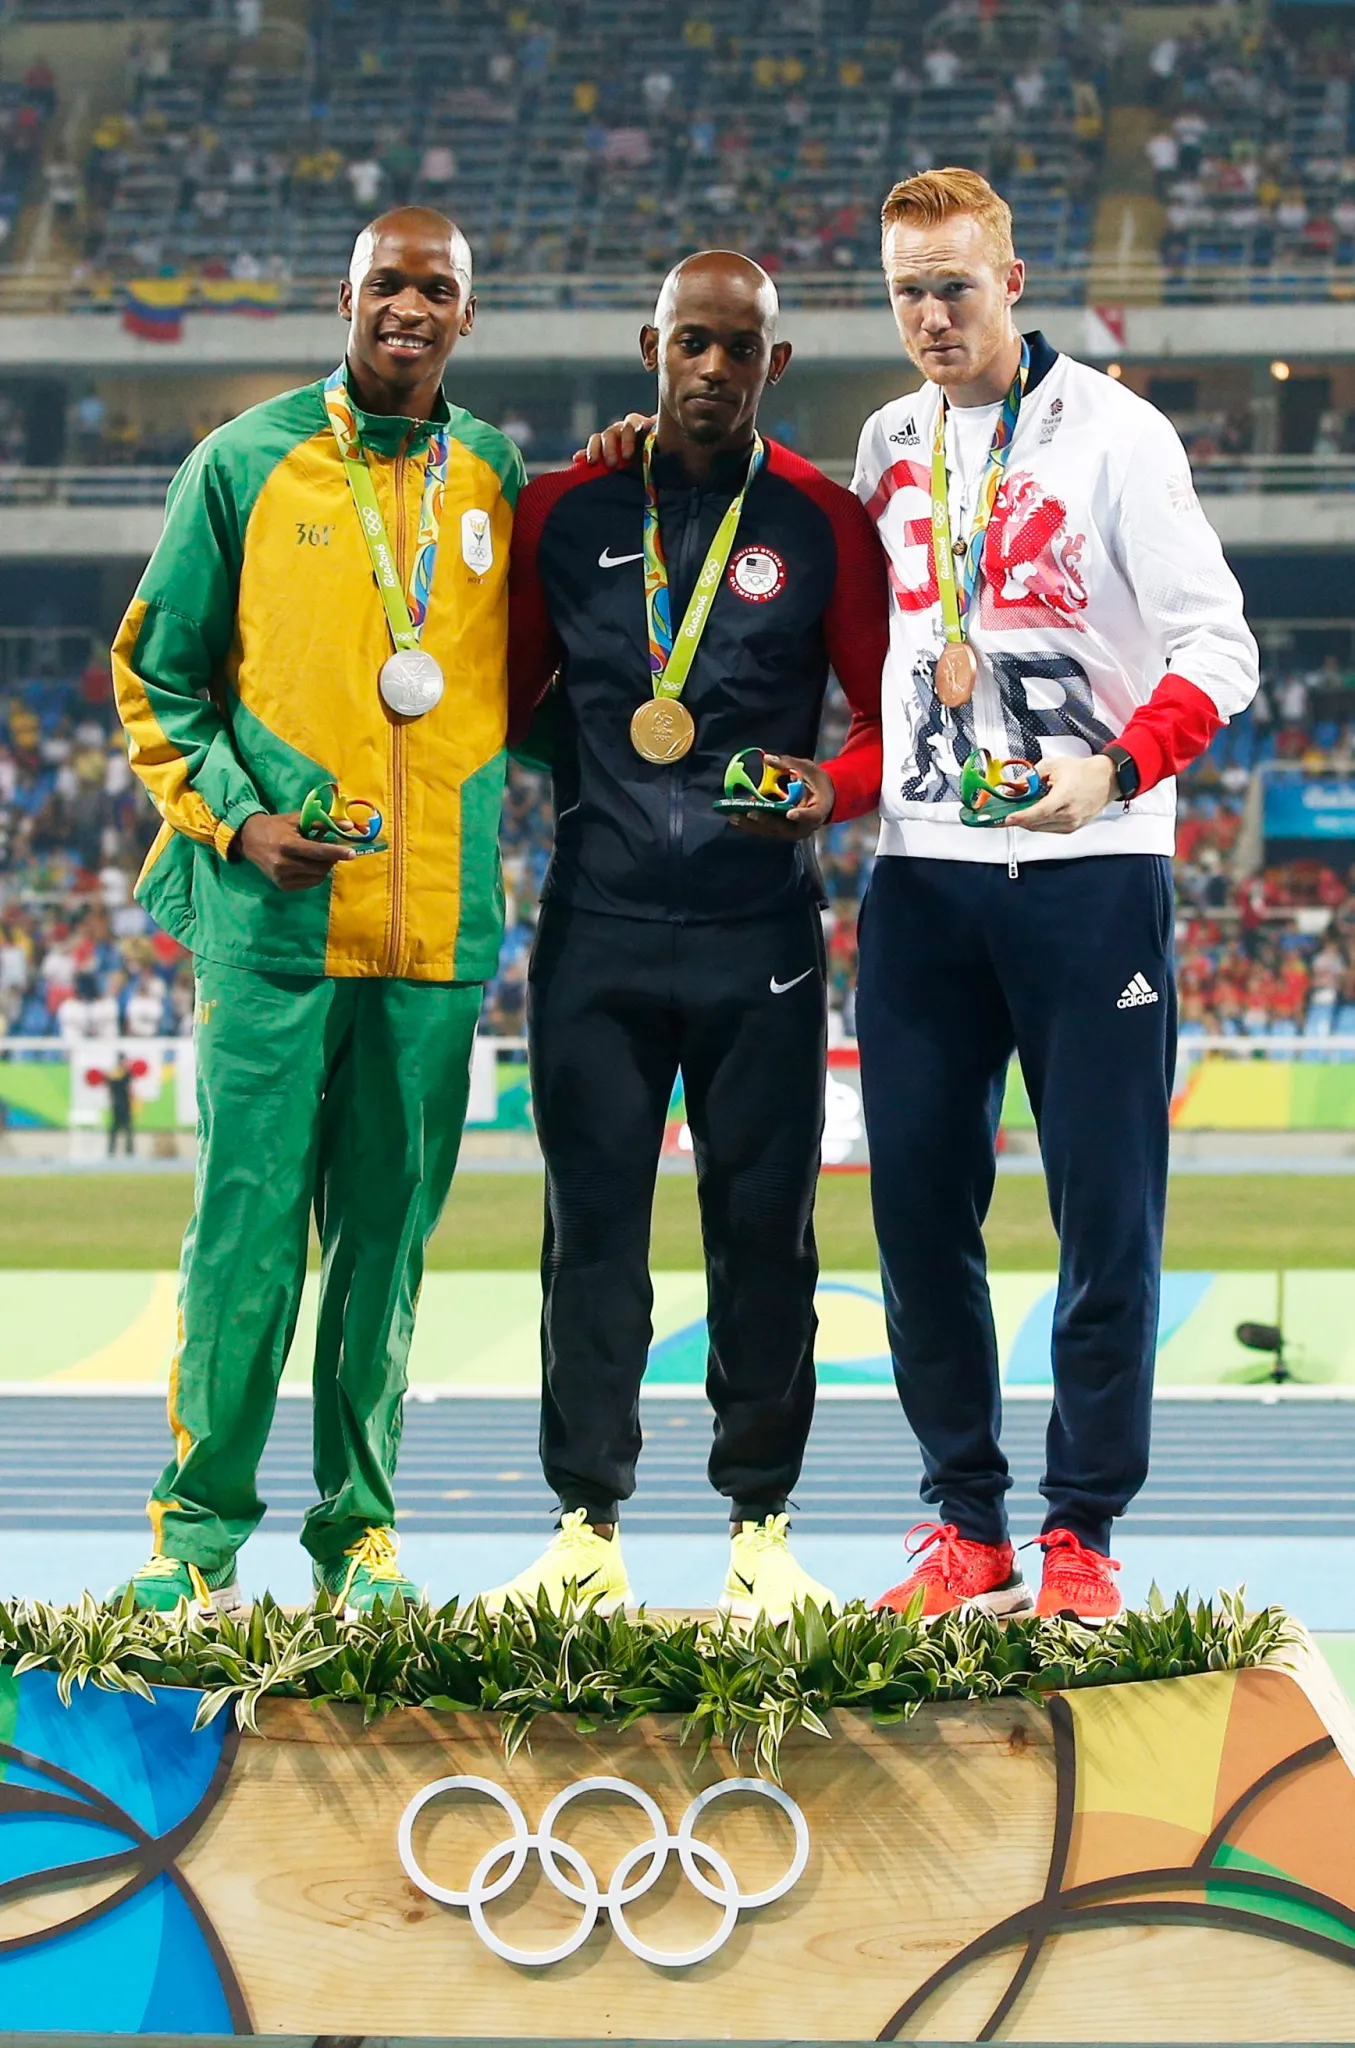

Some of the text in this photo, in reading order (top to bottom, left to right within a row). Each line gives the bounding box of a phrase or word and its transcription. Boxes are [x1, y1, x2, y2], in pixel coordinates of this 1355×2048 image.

[889, 434, 921, 446] adidas
[374, 544, 396, 587] Rio2016
[734, 547, 783, 566] UNITED STATES
[937, 535, 951, 580] Rio2016
[730, 576, 782, 600] OLYMPIC TEAM
[685, 595, 708, 637] Rio2016
[1116, 991, 1159, 1009] adidas
